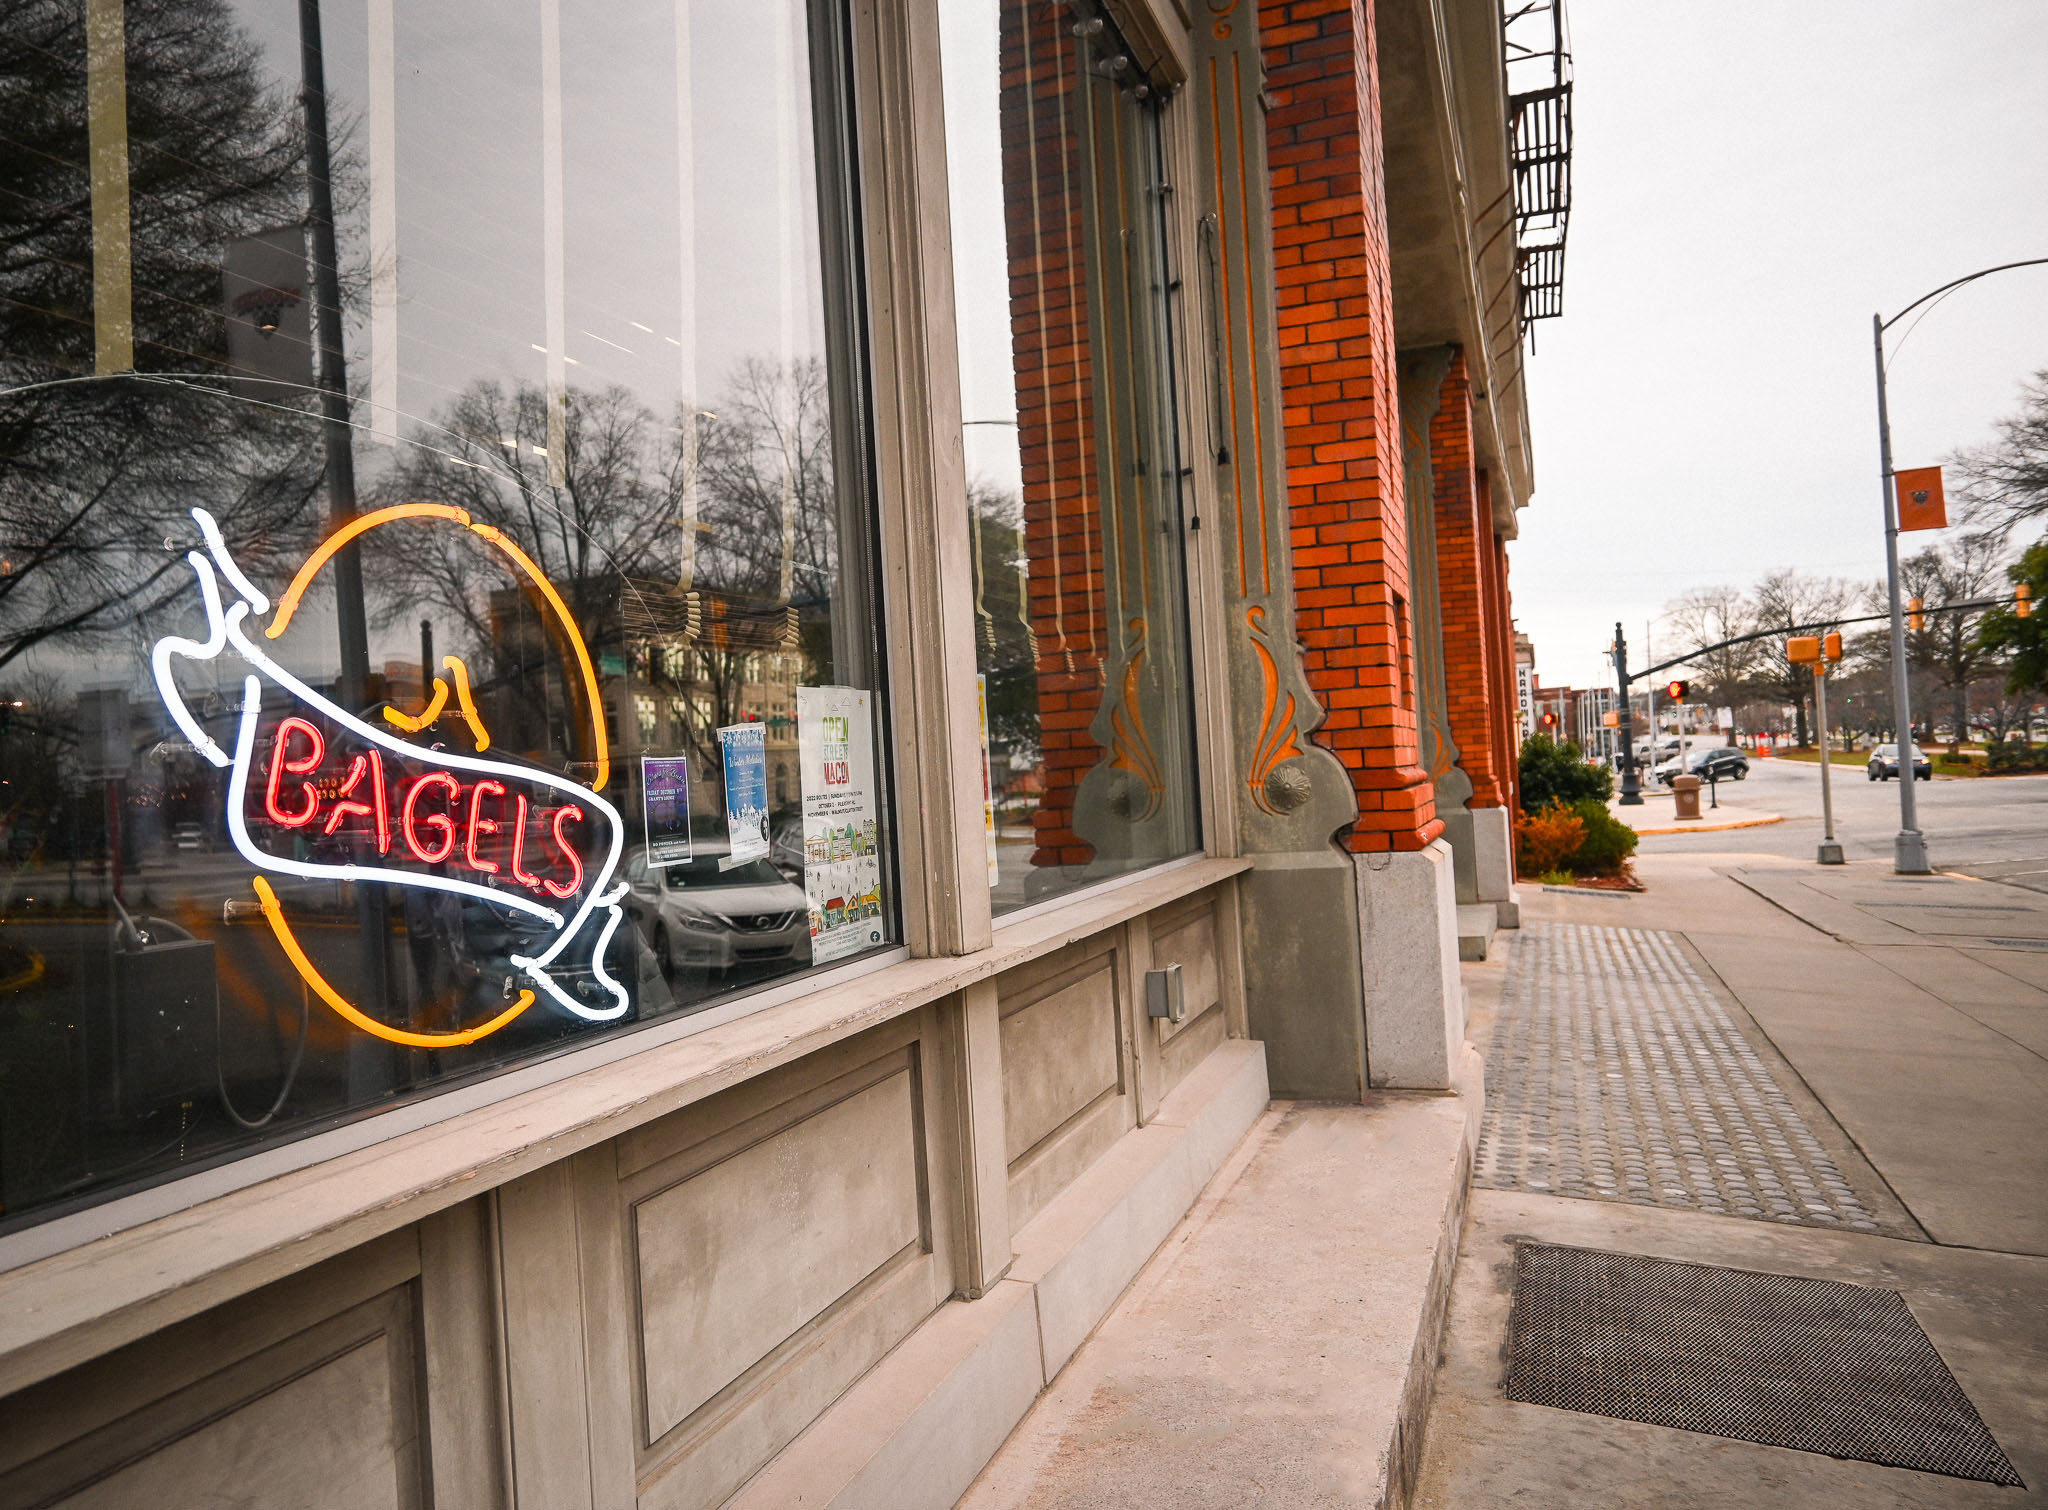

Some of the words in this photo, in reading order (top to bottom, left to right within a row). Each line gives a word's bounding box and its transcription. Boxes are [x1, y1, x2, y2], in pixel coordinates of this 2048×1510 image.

[823, 716, 849, 742] OPEN
[823, 761, 850, 785] MACON
[266, 717, 584, 898] BAGELS
